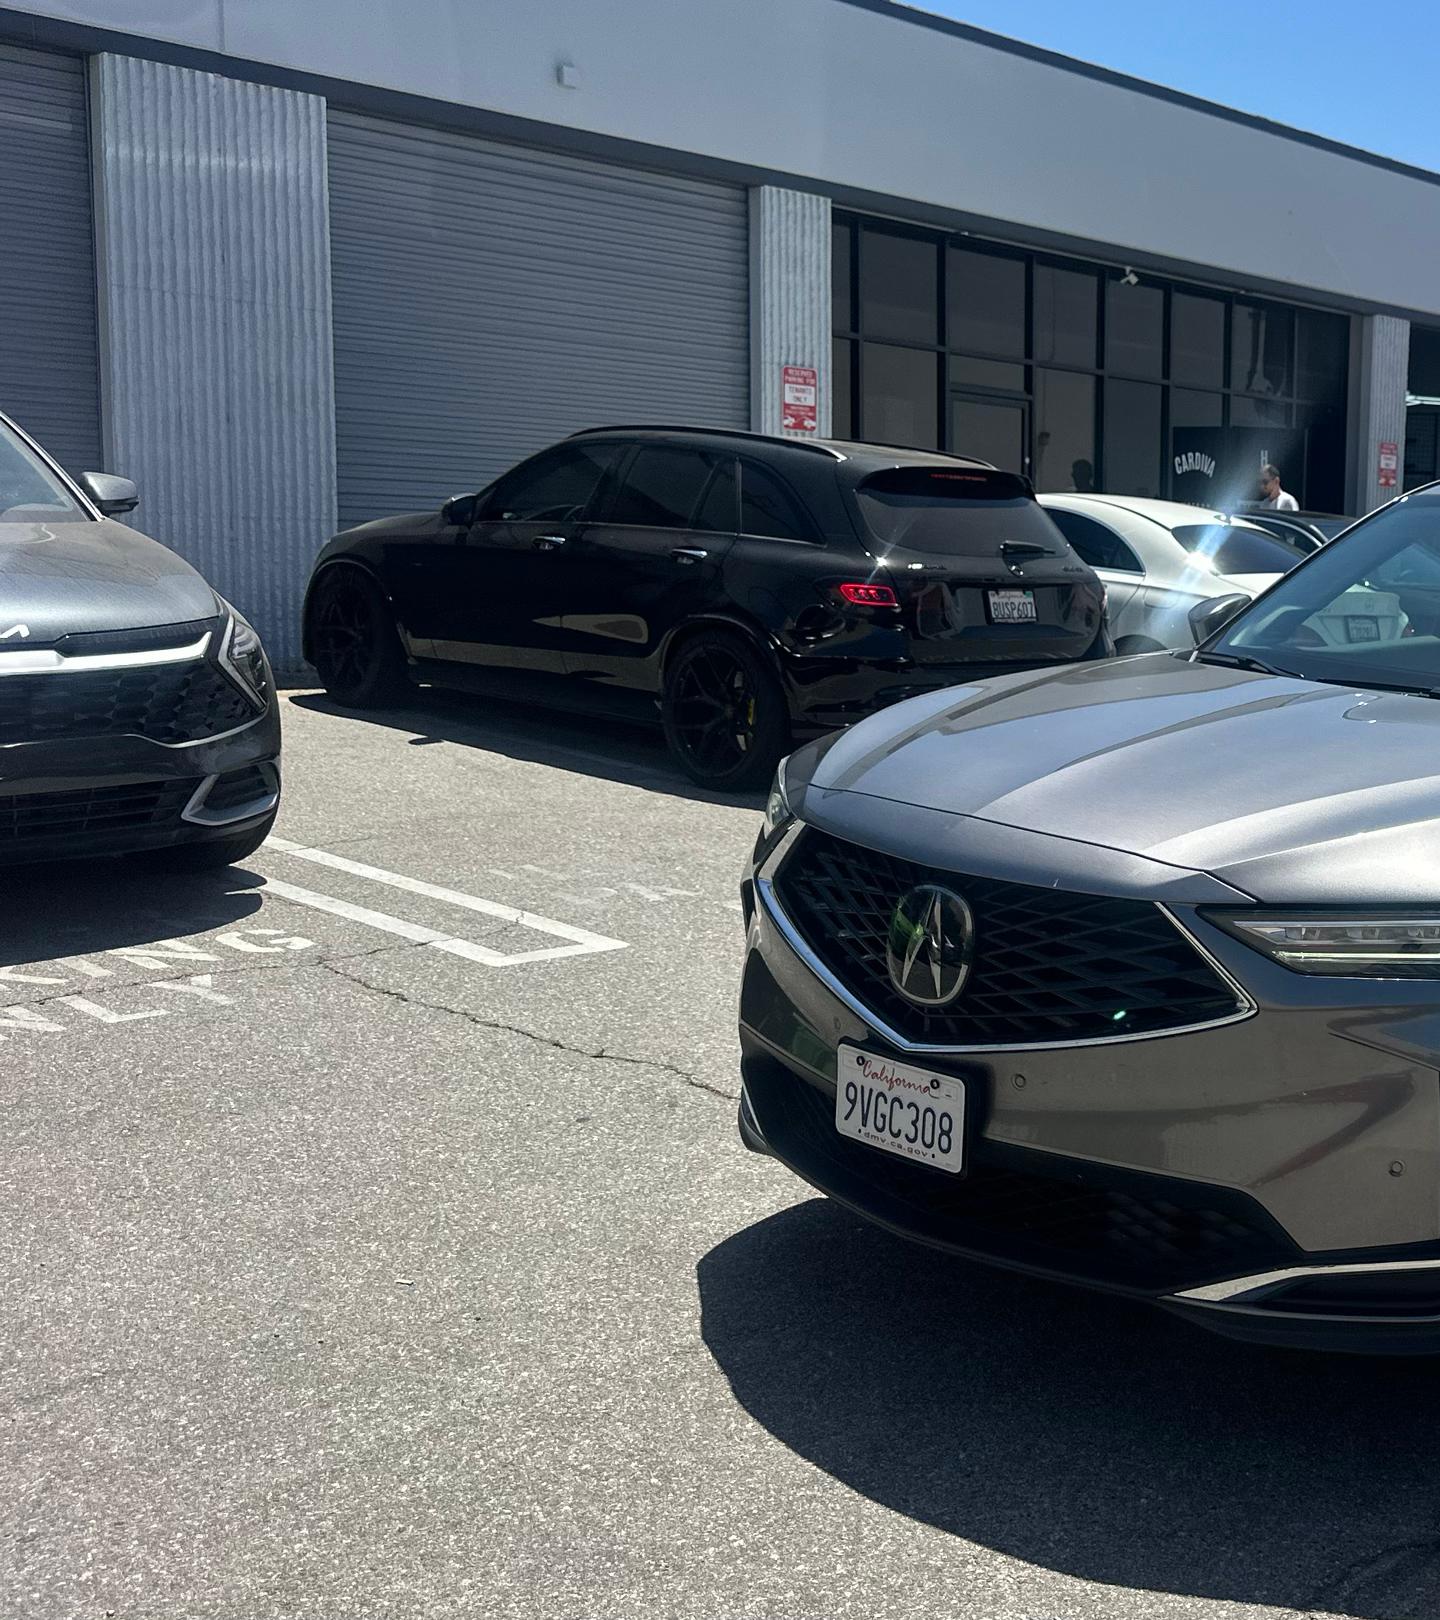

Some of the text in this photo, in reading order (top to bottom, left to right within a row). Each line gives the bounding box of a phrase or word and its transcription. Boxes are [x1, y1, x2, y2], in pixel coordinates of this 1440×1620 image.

[1174, 452, 1216, 478] CARDIVA
[992, 601, 1034, 618] 8USP607
[862, 1060, 940, 1099] California
[844, 1081, 953, 1154] 9VGC308
[864, 1131, 928, 1157] dmv.ca.gov
